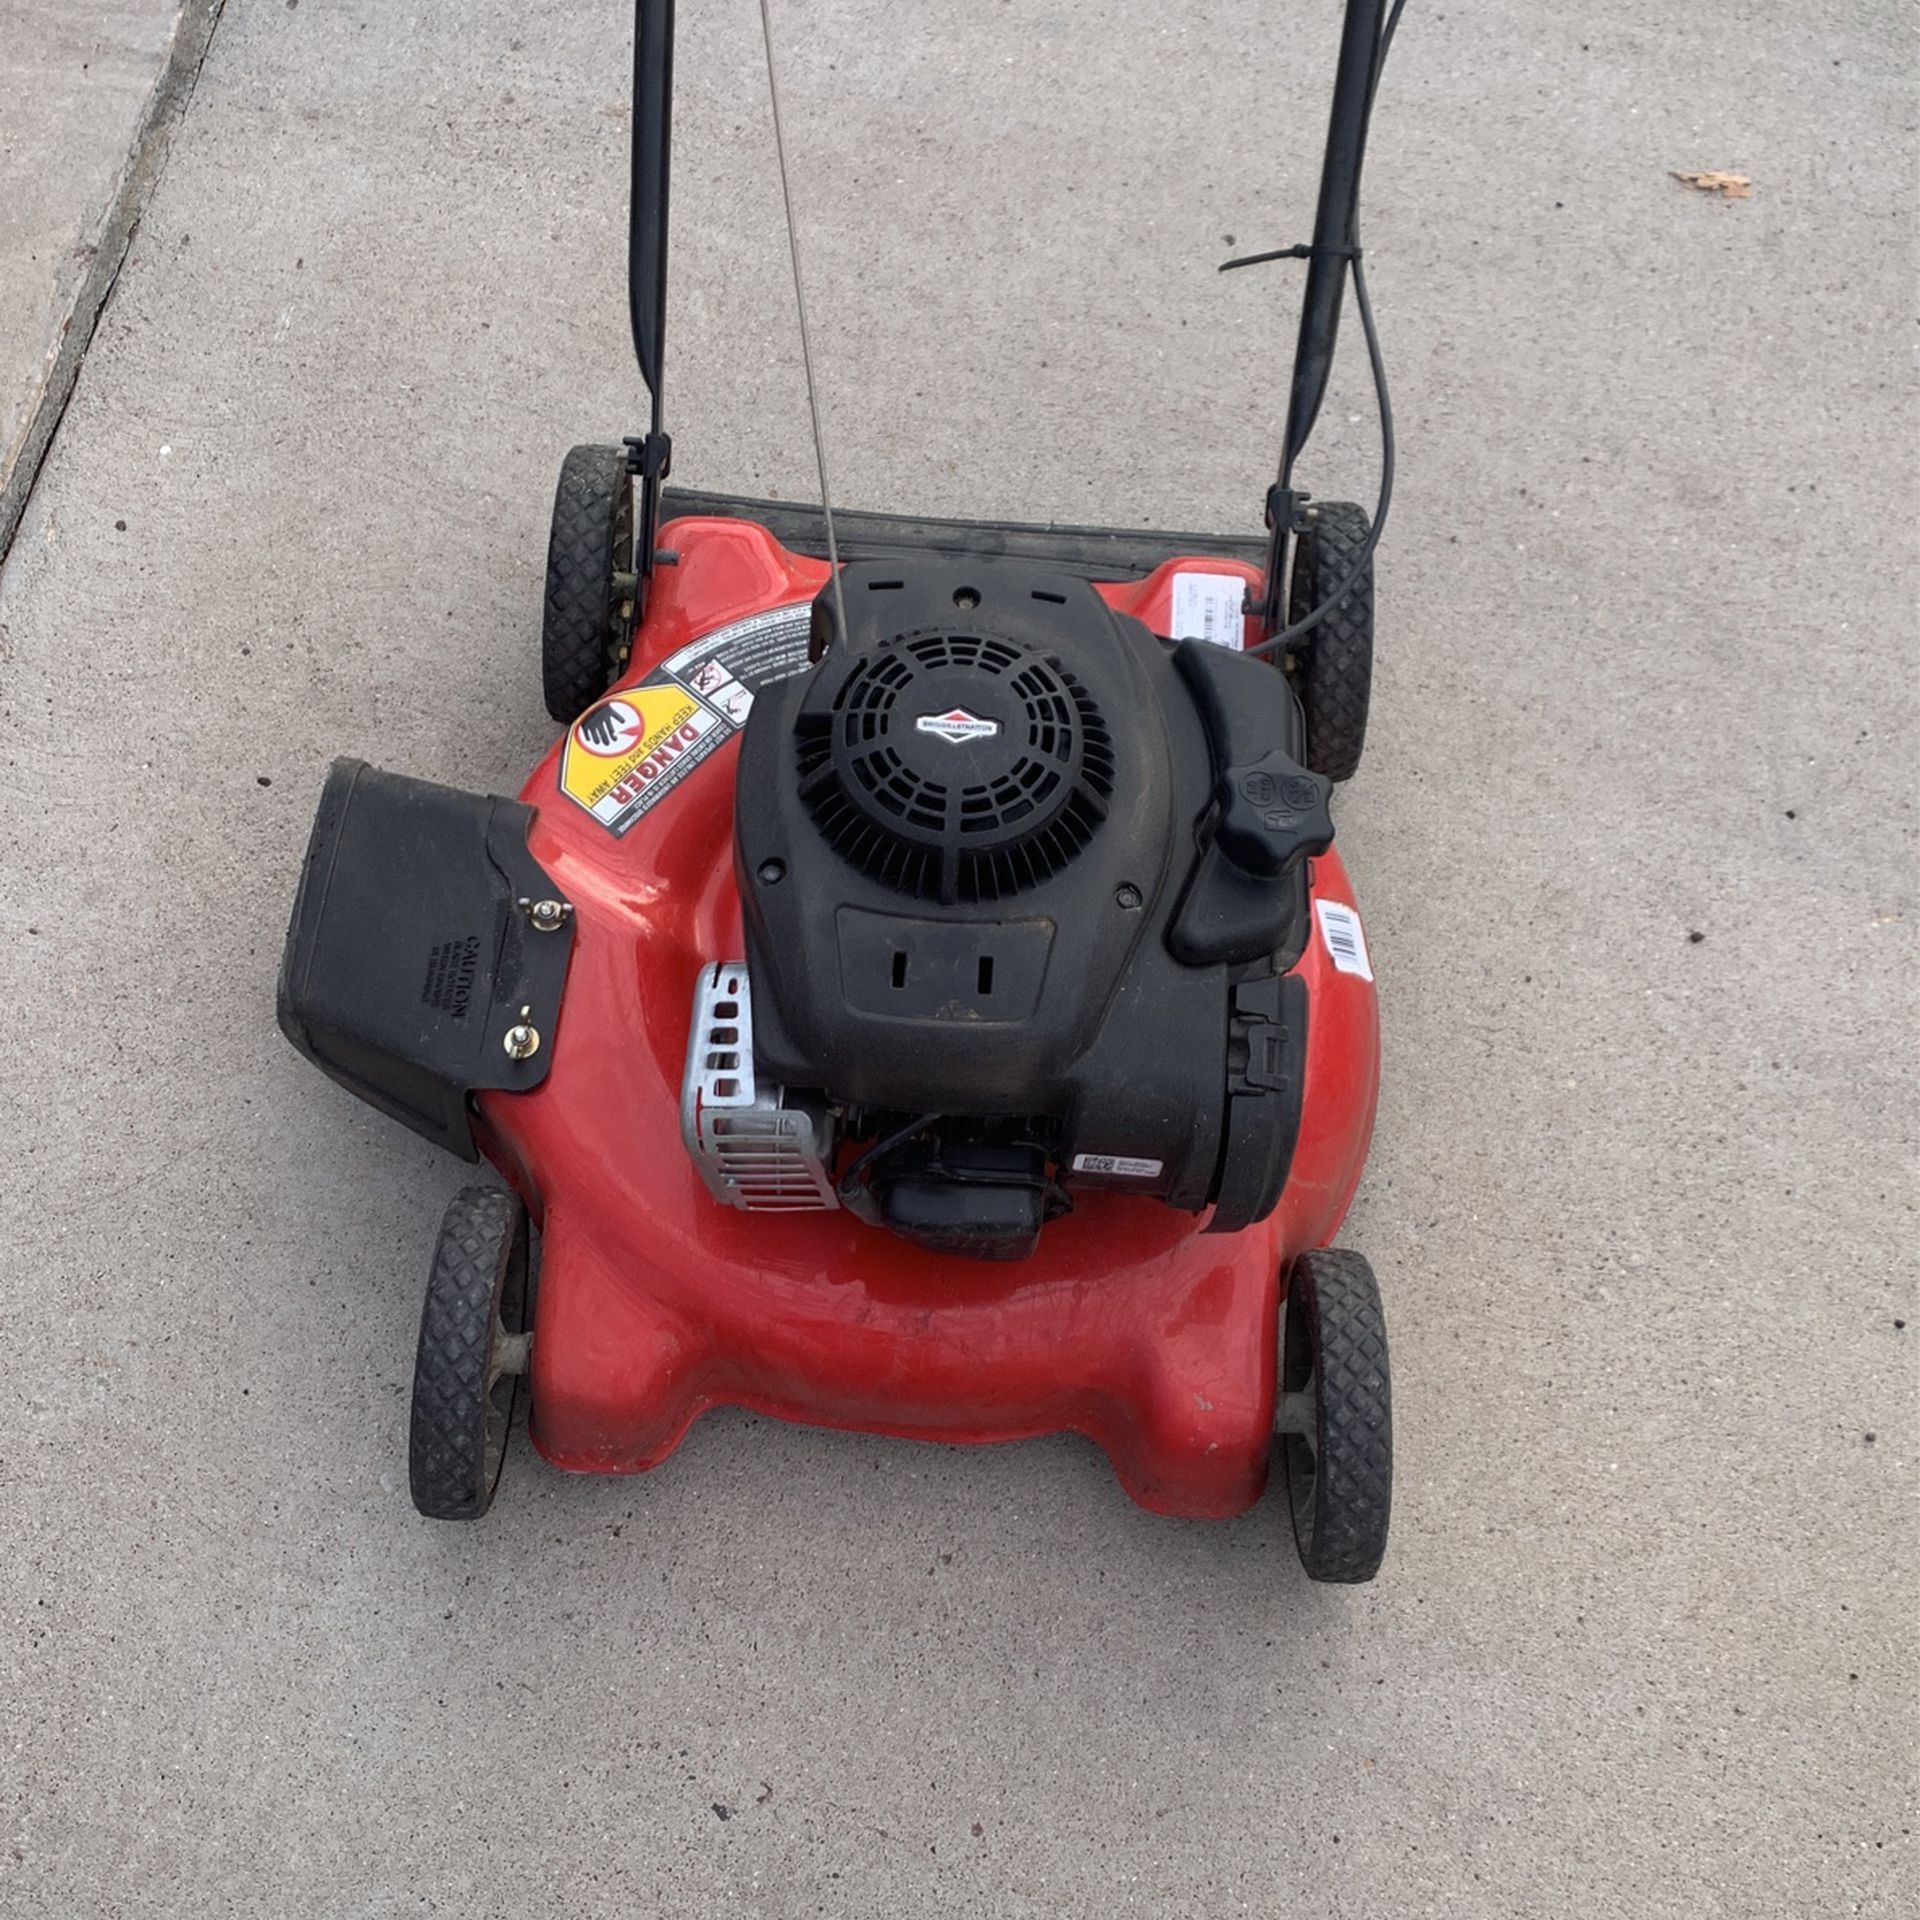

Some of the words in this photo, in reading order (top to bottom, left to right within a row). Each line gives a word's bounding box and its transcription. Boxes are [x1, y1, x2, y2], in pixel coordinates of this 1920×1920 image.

[670, 703, 693, 726] KEEP
[642, 722, 673, 751] HANDS
[608, 722, 699, 806] DANGER
[628, 747, 645, 764] and
[608, 760, 631, 782] FEET
[585, 779, 611, 804] AWAY
[450, 935, 481, 1017] CAUTION
